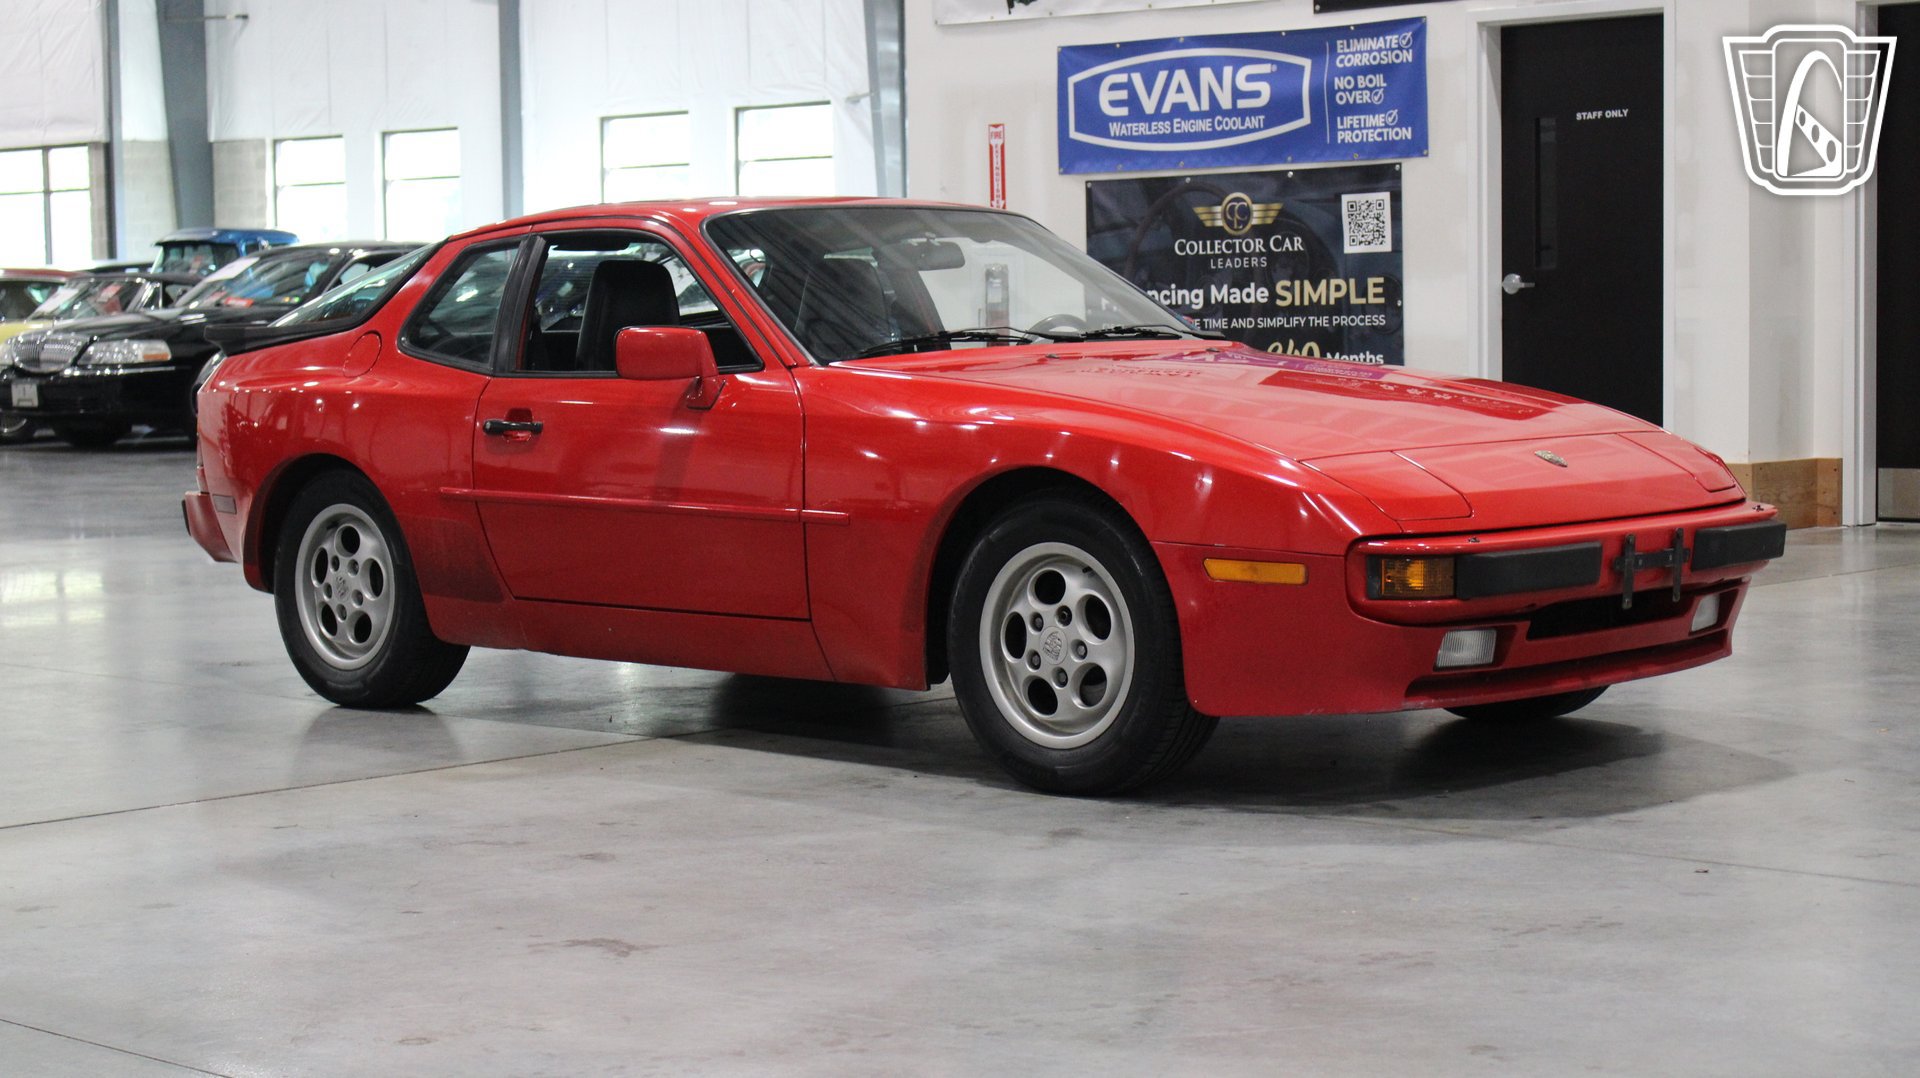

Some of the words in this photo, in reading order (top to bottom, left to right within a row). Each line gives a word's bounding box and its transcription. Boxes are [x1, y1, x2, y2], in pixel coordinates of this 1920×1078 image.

[1337, 35, 1399, 53] ELIMINATE
[1336, 49, 1413, 68] CORROSION
[1098, 63, 1272, 117] EVANS
[1334, 75, 1355, 90] NO
[1357, 73, 1387, 88] BOIL
[1335, 89, 1371, 105] OVER
[1337, 113, 1386, 129] LIFETIME
[1576, 110, 1603, 121] STAFF
[1605, 108, 1629, 119] ONLY
[1109, 121, 1171, 137] WATERLESS
[1173, 117, 1213, 133] ENGINE
[1214, 114, 1265, 131] COOLANT
[1337, 126, 1412, 144] PROTECTION
[1174, 238, 1266, 256] COLLECTOR
[1269, 234, 1304, 252] CAR
[1210, 256, 1267, 269] LEADERS
[1210, 282, 1269, 304] Made
[1275, 276, 1385, 307] SIMPLE
[1204, 318, 1228, 329] TIME
[1230, 317, 1256, 329] AND
[1257, 315, 1306, 328] SIMPLIFY
[1308, 315, 1330, 327] THE
[1332, 314, 1386, 327] PROCESS
